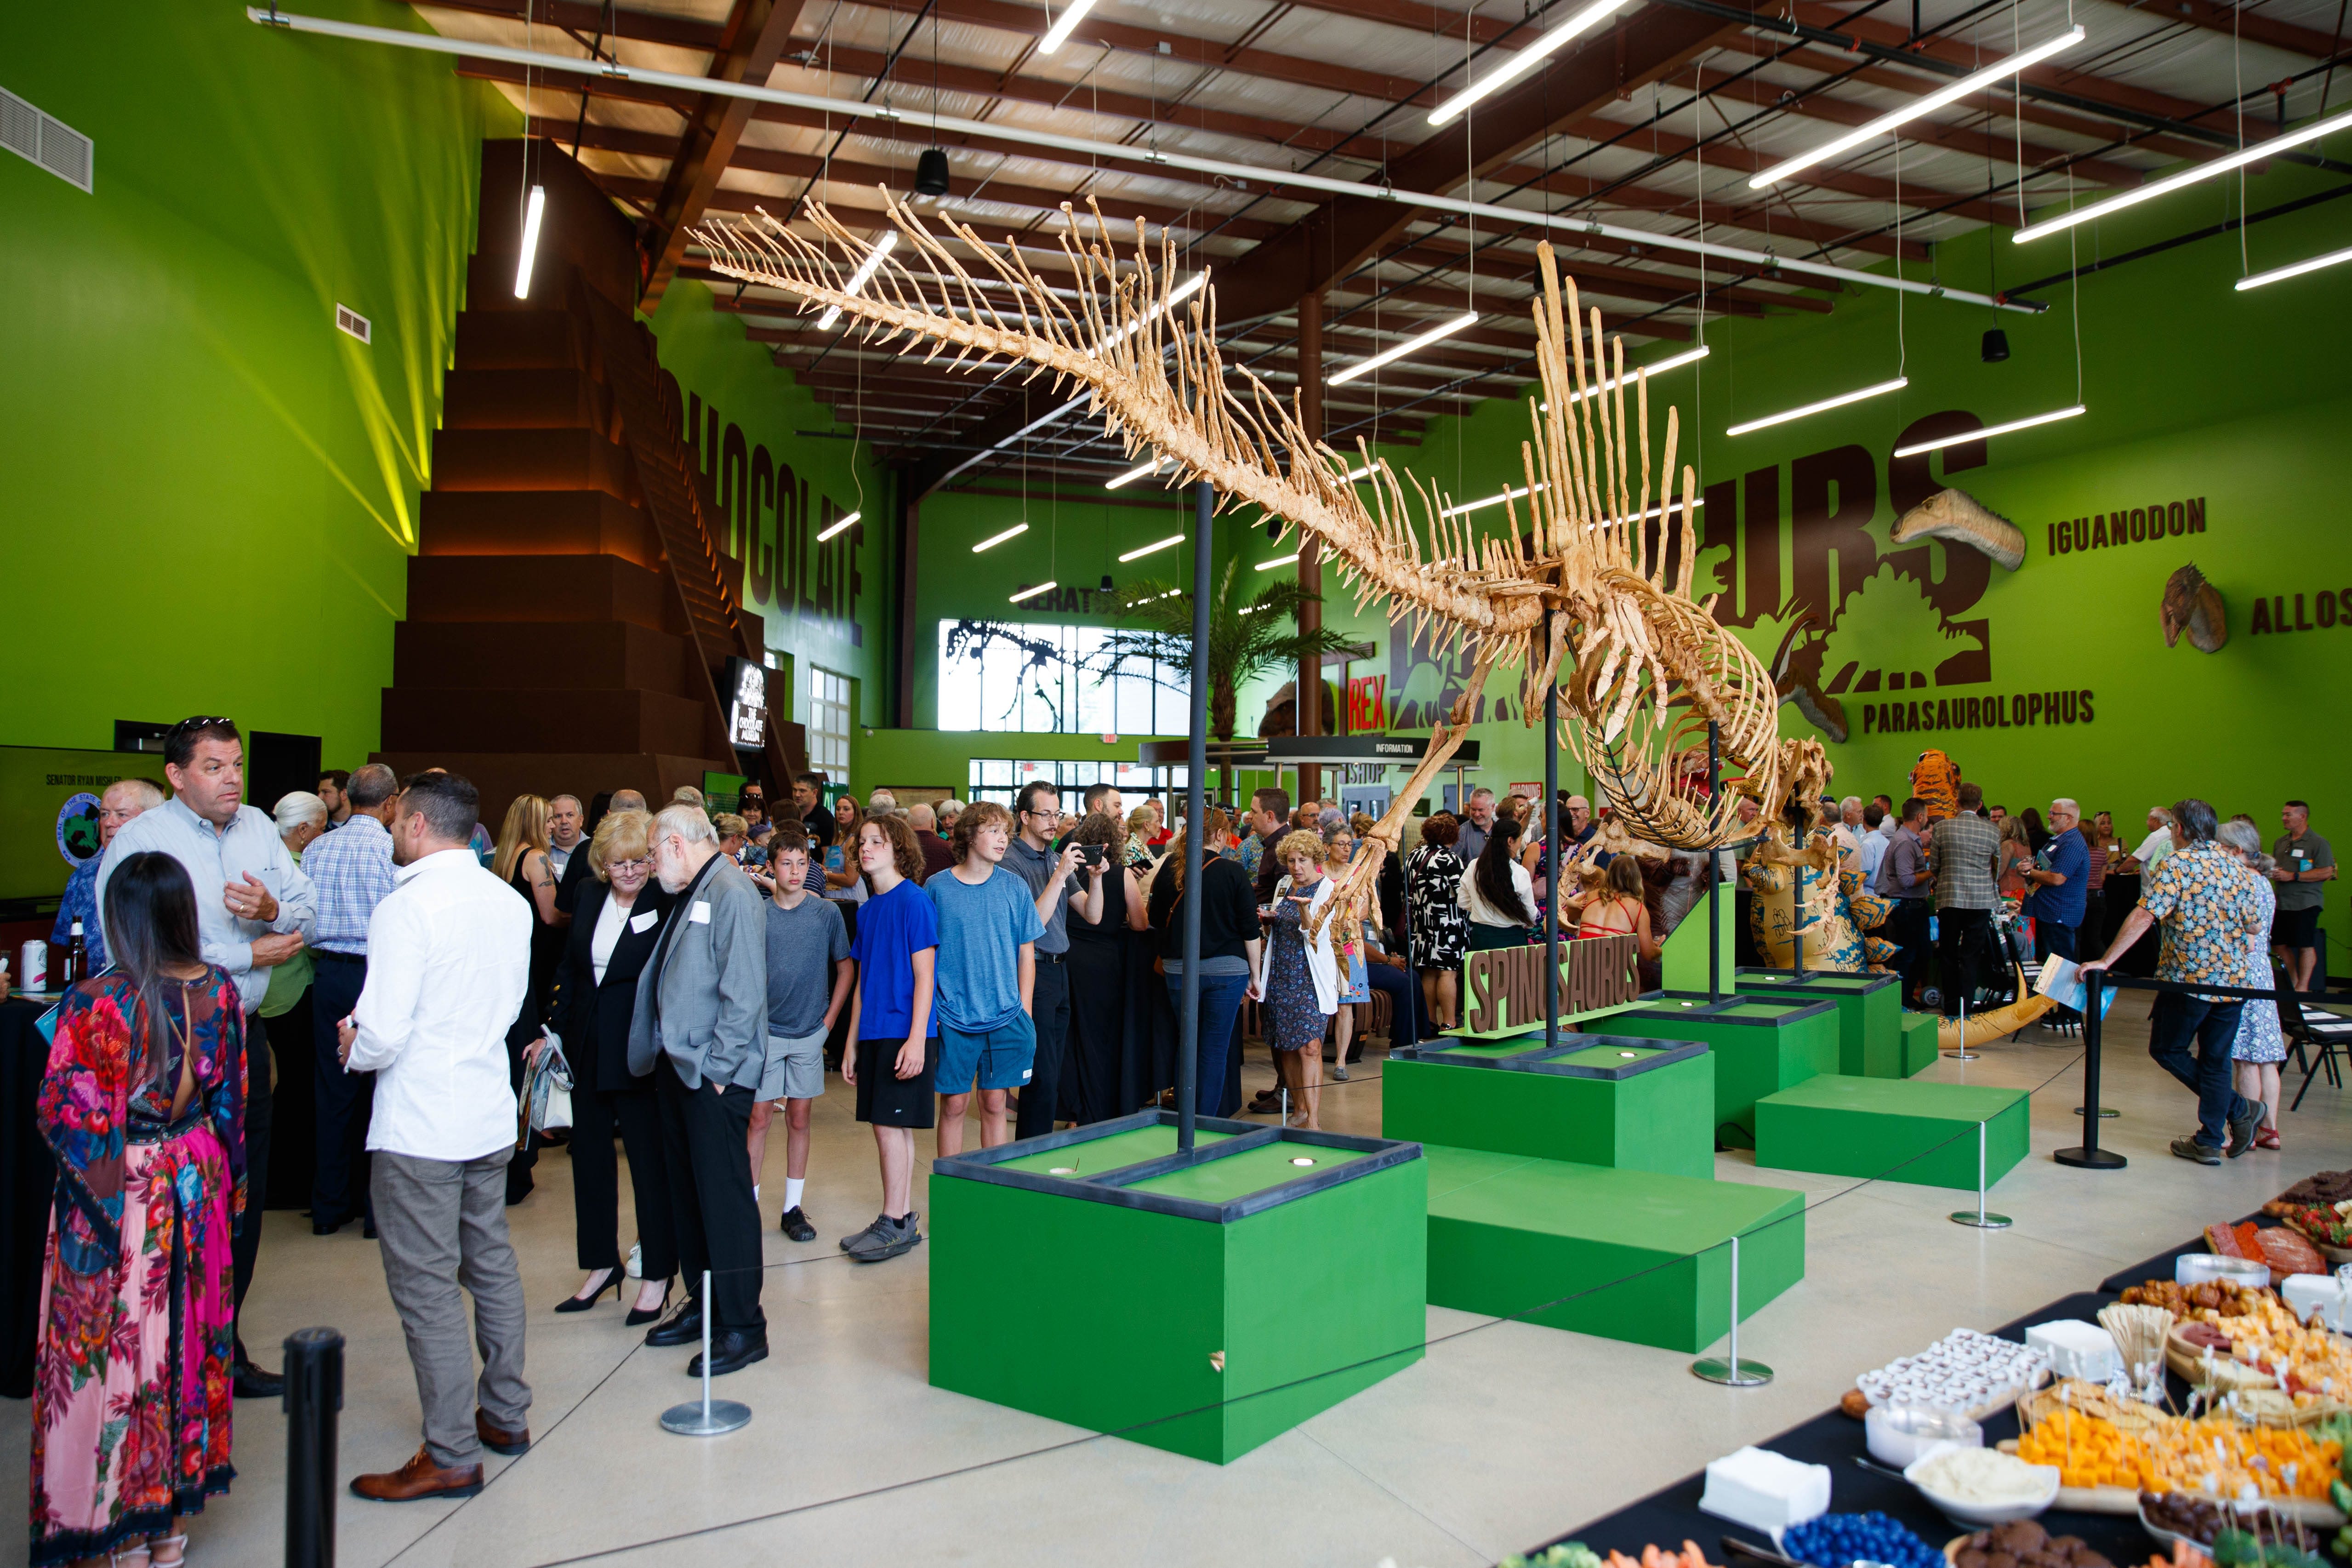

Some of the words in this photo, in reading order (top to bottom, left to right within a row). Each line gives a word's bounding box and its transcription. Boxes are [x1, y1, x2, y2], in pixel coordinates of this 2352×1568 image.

[2048, 497, 2206, 556] IGUANODON
[1017, 584, 1094, 613] CERAT
[1348, 674, 1385, 731] REX
[748, 707, 757, 720] THE
[1864, 690, 2094, 733] PARASAUROLOPHUS
[739, 717, 763, 732] CHOCOLATE
[741, 729, 760, 742] MUSEUM
[1376, 743, 1412, 753] INFORMATION
[47, 774, 75, 785] SENATOR
[77, 775, 94, 786] RYAN
[1349, 764, 1385, 784] SHOP
[79, 794, 97, 802] STATE
[1469, 934, 1640, 1033] SPINOSAURUS
